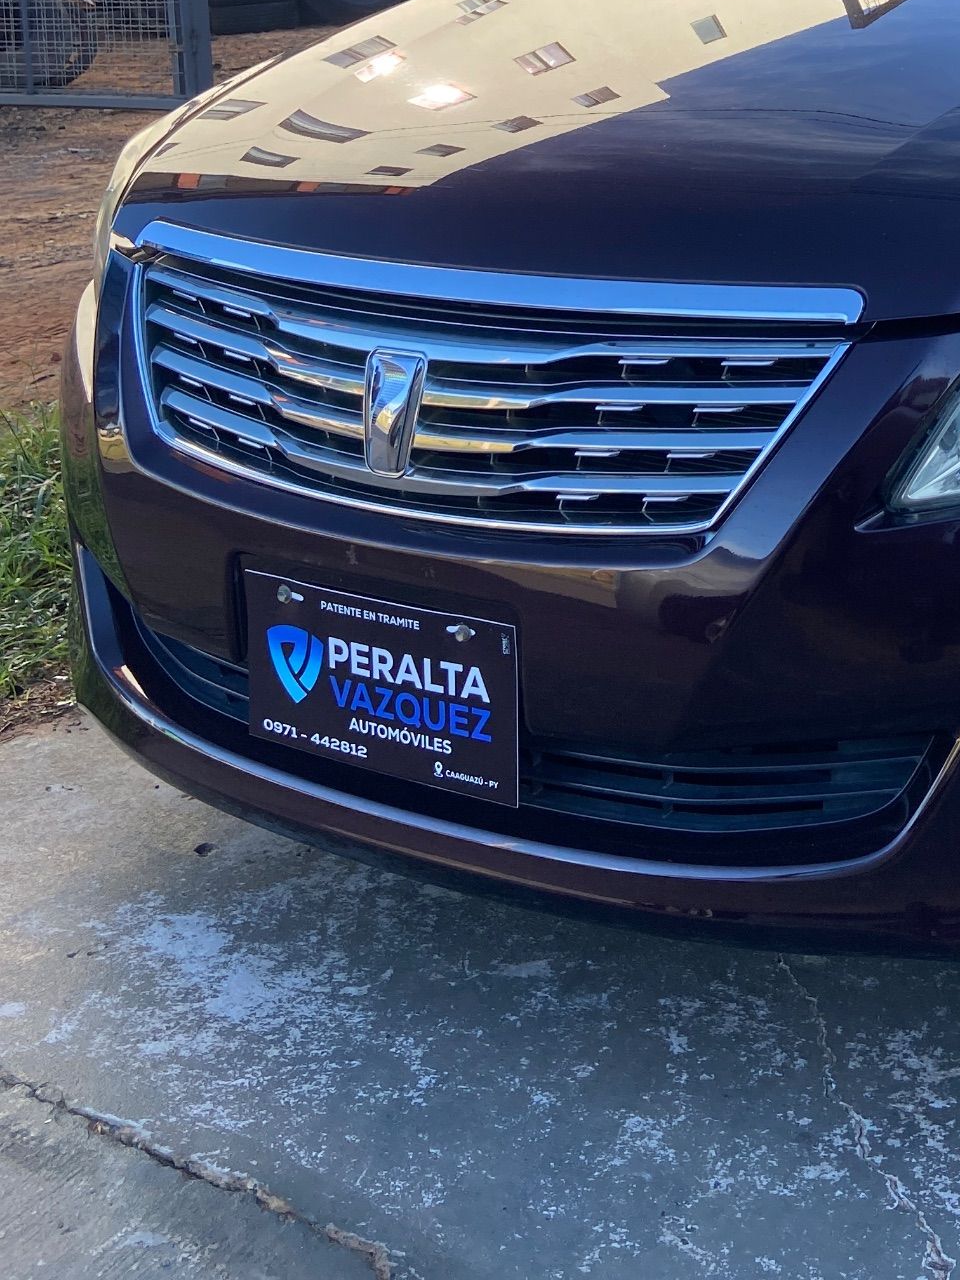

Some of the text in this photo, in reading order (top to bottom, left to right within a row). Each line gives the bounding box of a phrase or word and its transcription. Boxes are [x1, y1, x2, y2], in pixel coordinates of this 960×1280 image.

[320, 600, 420, 631] PATENTE EN TRAMITE
[327, 636, 491, 703] PERALTA
[329, 675, 492, 743] VAZQUEZ
[263, 718, 298, 739] 0971
[310, 732, 368, 758] 442812
[348, 717, 452, 754] AUTOMÓVILES
